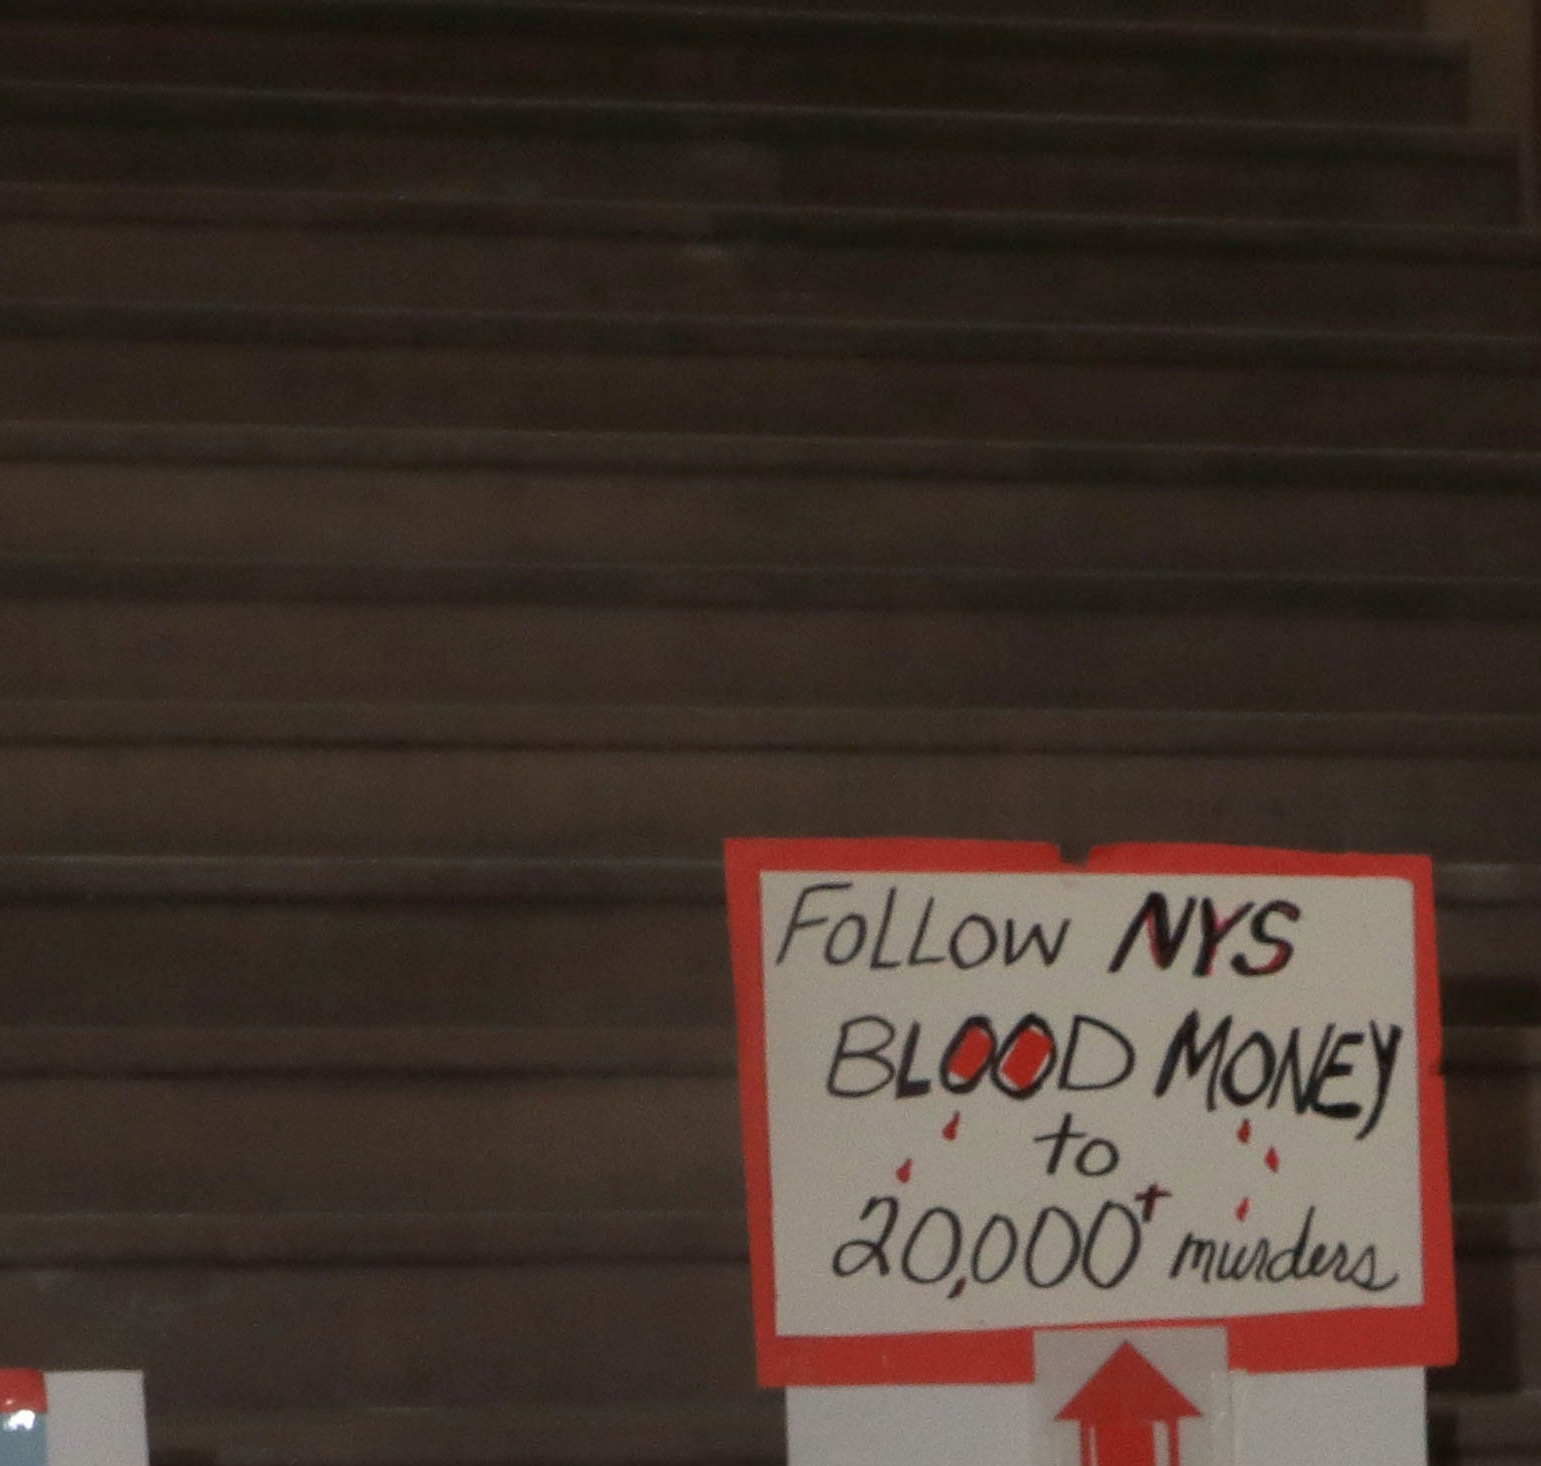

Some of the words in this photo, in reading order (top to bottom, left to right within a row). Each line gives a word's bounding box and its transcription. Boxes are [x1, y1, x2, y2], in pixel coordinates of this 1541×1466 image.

[775, 882, 1070, 968] FOLLOW
[1109, 892, 1301, 977] NYS
[826, 1013, 1134, 1101] BLOOD
[1155, 1010, 1400, 1138] MONEY
[1034, 1113, 1118, 1176] to
[1170, 1208, 1397, 1291] murders
